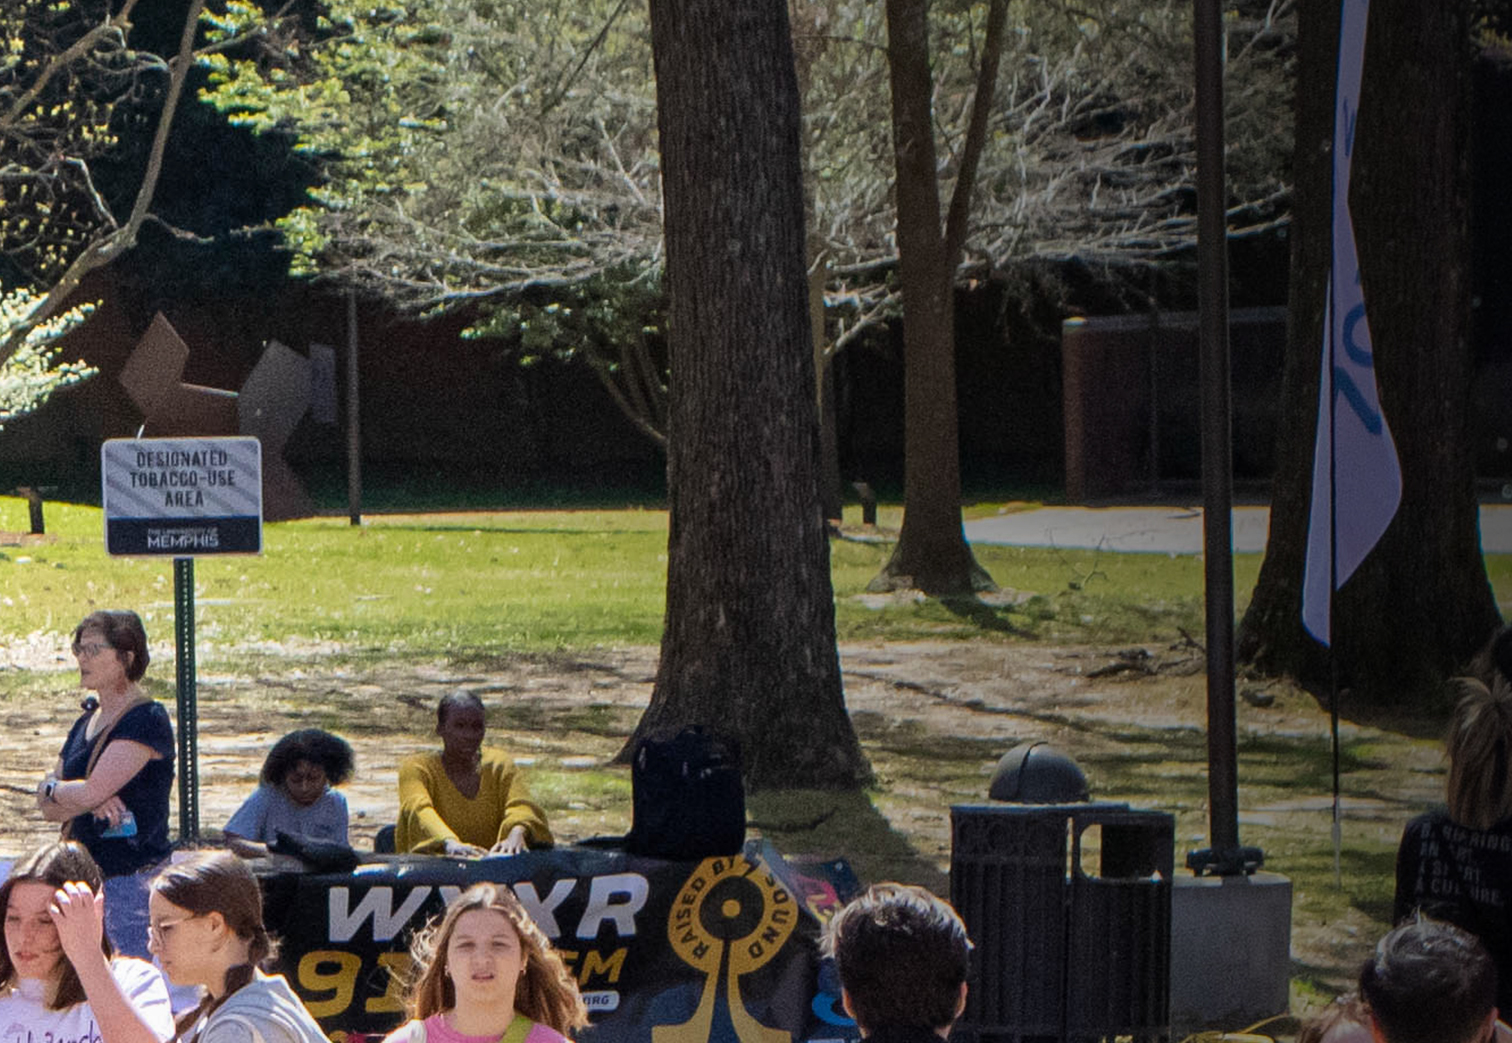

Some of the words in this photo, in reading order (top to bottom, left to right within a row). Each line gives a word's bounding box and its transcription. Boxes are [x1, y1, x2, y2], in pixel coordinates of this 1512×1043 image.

[137, 449, 228, 468] DESIGNATED
[129, 469, 236, 488] TOBACCO-USE
[164, 490, 204, 508] AREA
[147, 534, 219, 549] MEMPHIS
[328, 873, 650, 942] WXR
[676, 876, 710, 960] RAISED
[712, 856, 737, 876] BY
[748, 875, 791, 960] SOUND
